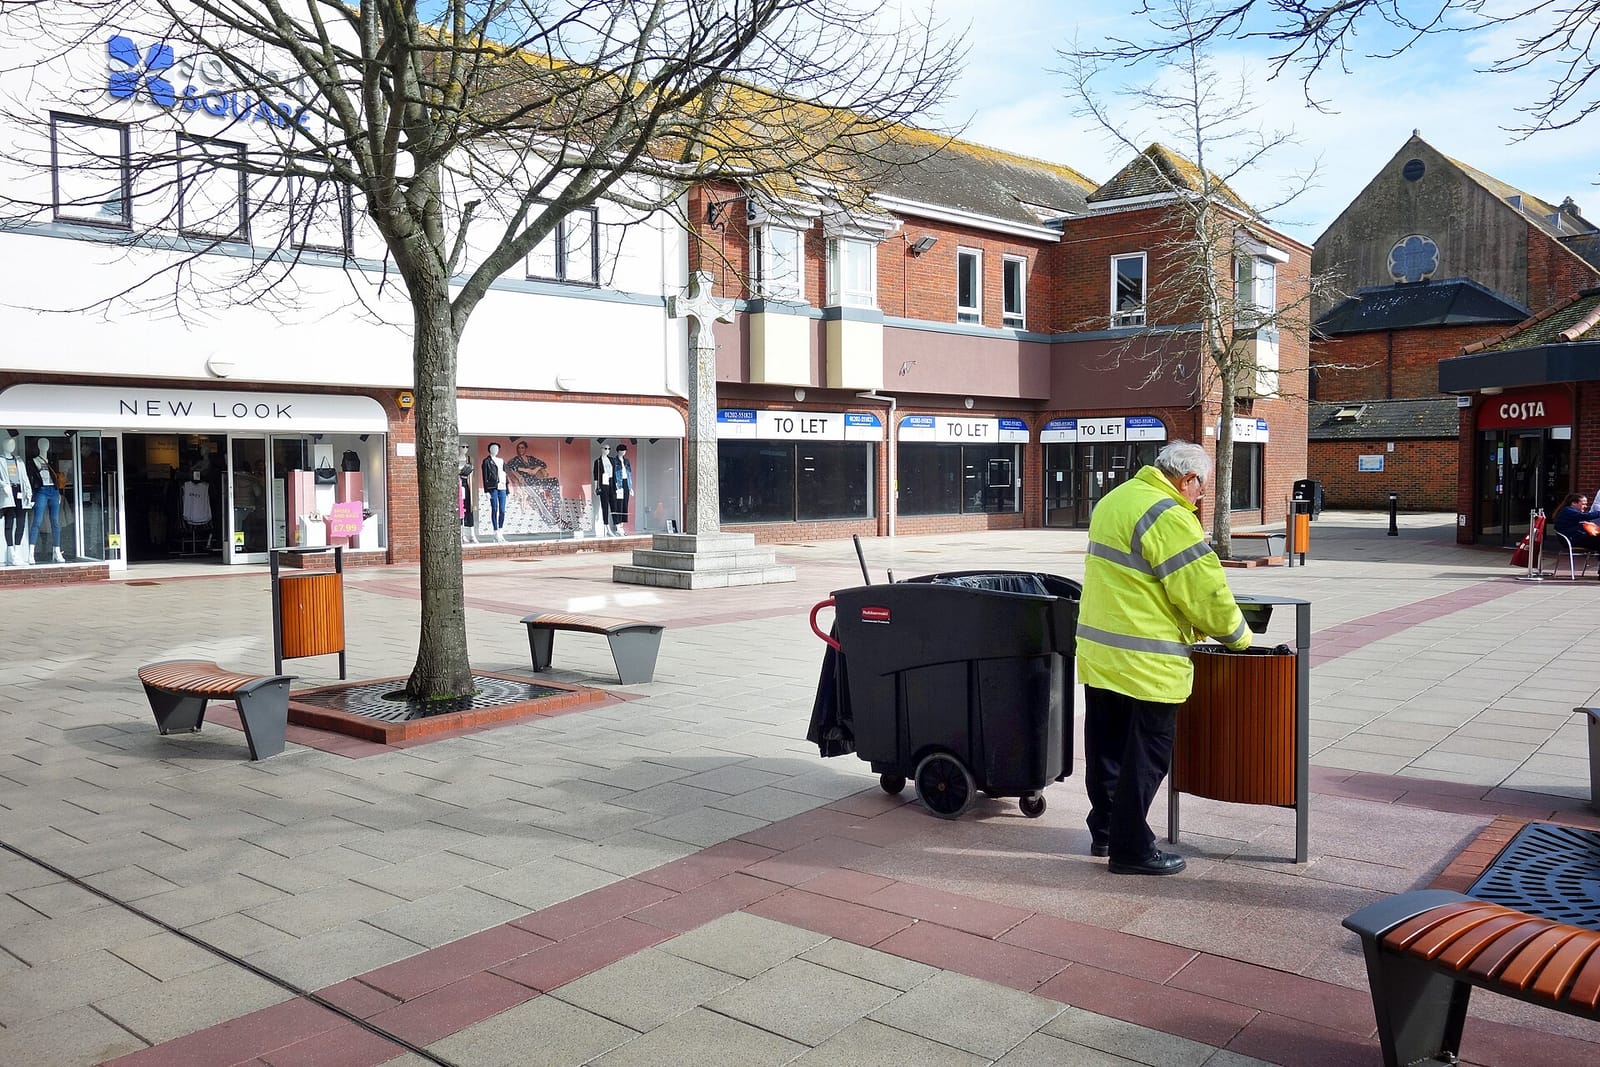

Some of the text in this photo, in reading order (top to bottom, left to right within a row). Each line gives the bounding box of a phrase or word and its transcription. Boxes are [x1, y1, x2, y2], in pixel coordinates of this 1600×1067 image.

[183, 85, 311, 131] SQUARE
[120, 399, 292, 419] NEW LOOK
[1500, 402, 1545, 420] COSTA
[774, 418, 828, 433] TO LET
[947, 423, 988, 437] TO LET
[1080, 424, 1121, 435] TO LET
